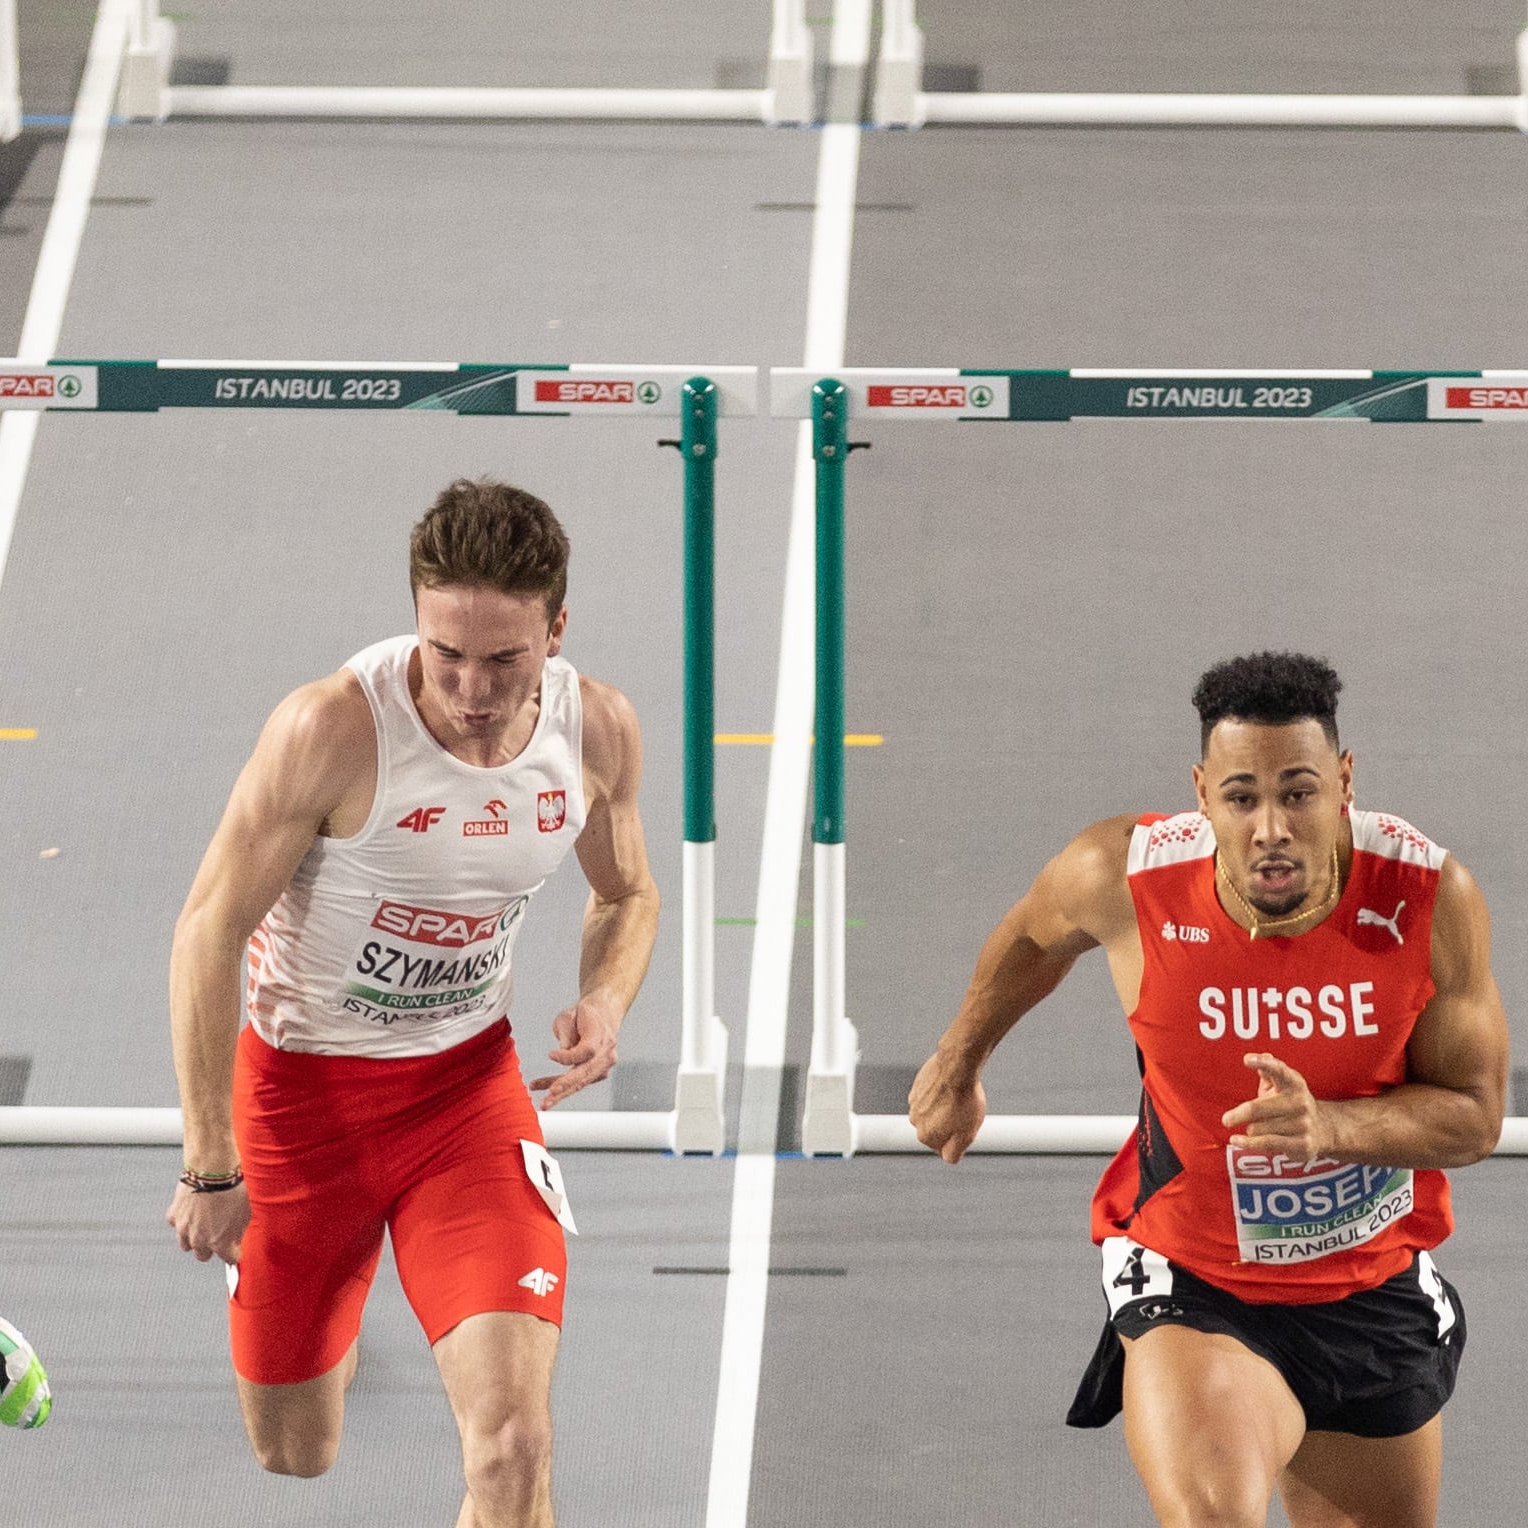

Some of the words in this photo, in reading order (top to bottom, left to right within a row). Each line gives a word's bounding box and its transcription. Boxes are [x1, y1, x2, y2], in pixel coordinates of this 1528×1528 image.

[215, 378, 336, 400] ISTANBUL
[342, 379, 401, 400] 2023
[558, 383, 633, 401] SPAR
[890, 387, 965, 405] SPAR
[1127, 387, 1247, 408] ISTANBUL
[1252, 387, 1312, 408] 2023
[465, 822, 506, 835] ORLEN
[1179, 926, 1210, 943] UBS
[356, 934, 510, 988] SZYMANSKI
[378, 994, 385, 1004] I
[387, 994, 423, 1008] RUN
[425, 987, 473, 1006] CLEAN
[1240, 1164, 1394, 1220] JOSEP
[1255, 1226, 1365, 1261] ISTANBUL
[1368, 1189, 1412, 1232] 2023
[1290, 1221, 1329, 1237] RUN
[1333, 1193, 1384, 1227] CLEAN
[1113, 1247, 1151, 1296] 4
